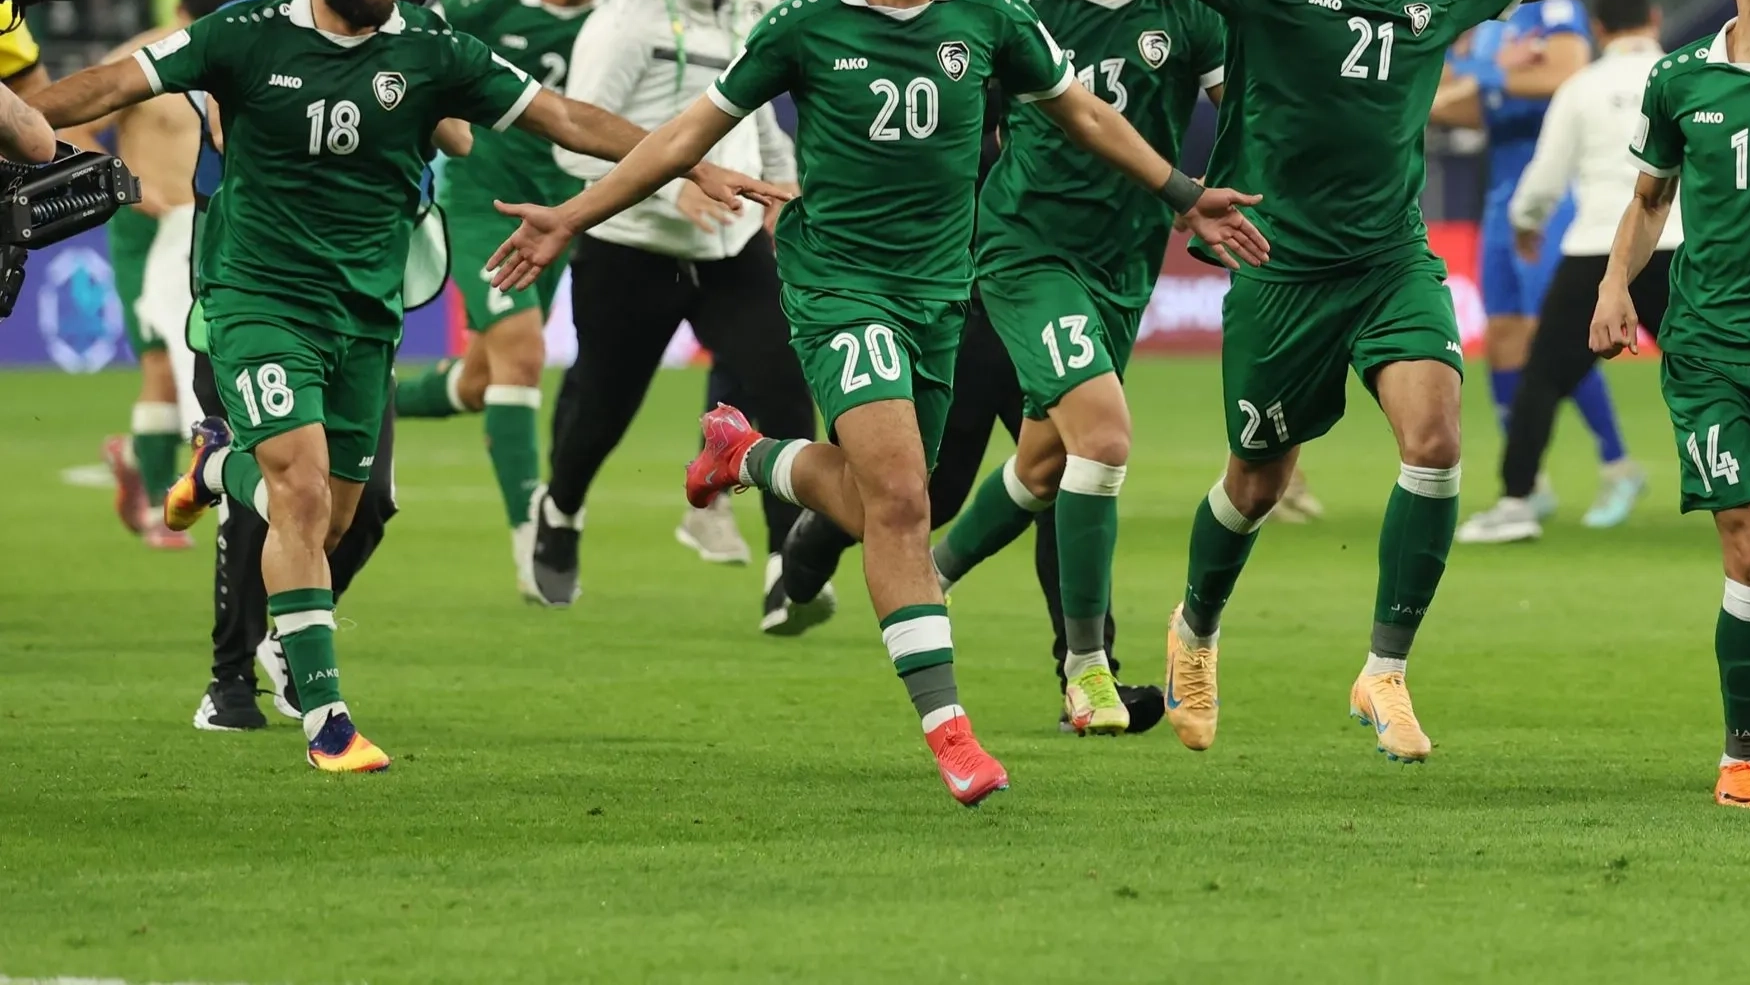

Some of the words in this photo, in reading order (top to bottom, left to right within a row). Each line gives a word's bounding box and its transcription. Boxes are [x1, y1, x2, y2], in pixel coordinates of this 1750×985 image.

[833, 57, 868, 71] JAKO
[1340, 16, 1394, 81] 21
[268, 73, 303, 89] JAKO
[868, 76, 940, 142] 20
[306, 99, 362, 156] 18
[1692, 111, 1725, 124] JAKO
[829, 323, 902, 395] 20
[1041, 314, 1095, 378] 13
[1445, 340, 1463, 357] JAK
[235, 362, 295, 427] 18
[1237, 398, 1290, 450] 21
[1686, 423, 1740, 494] 14
[306, 667, 340, 684] JAKO
